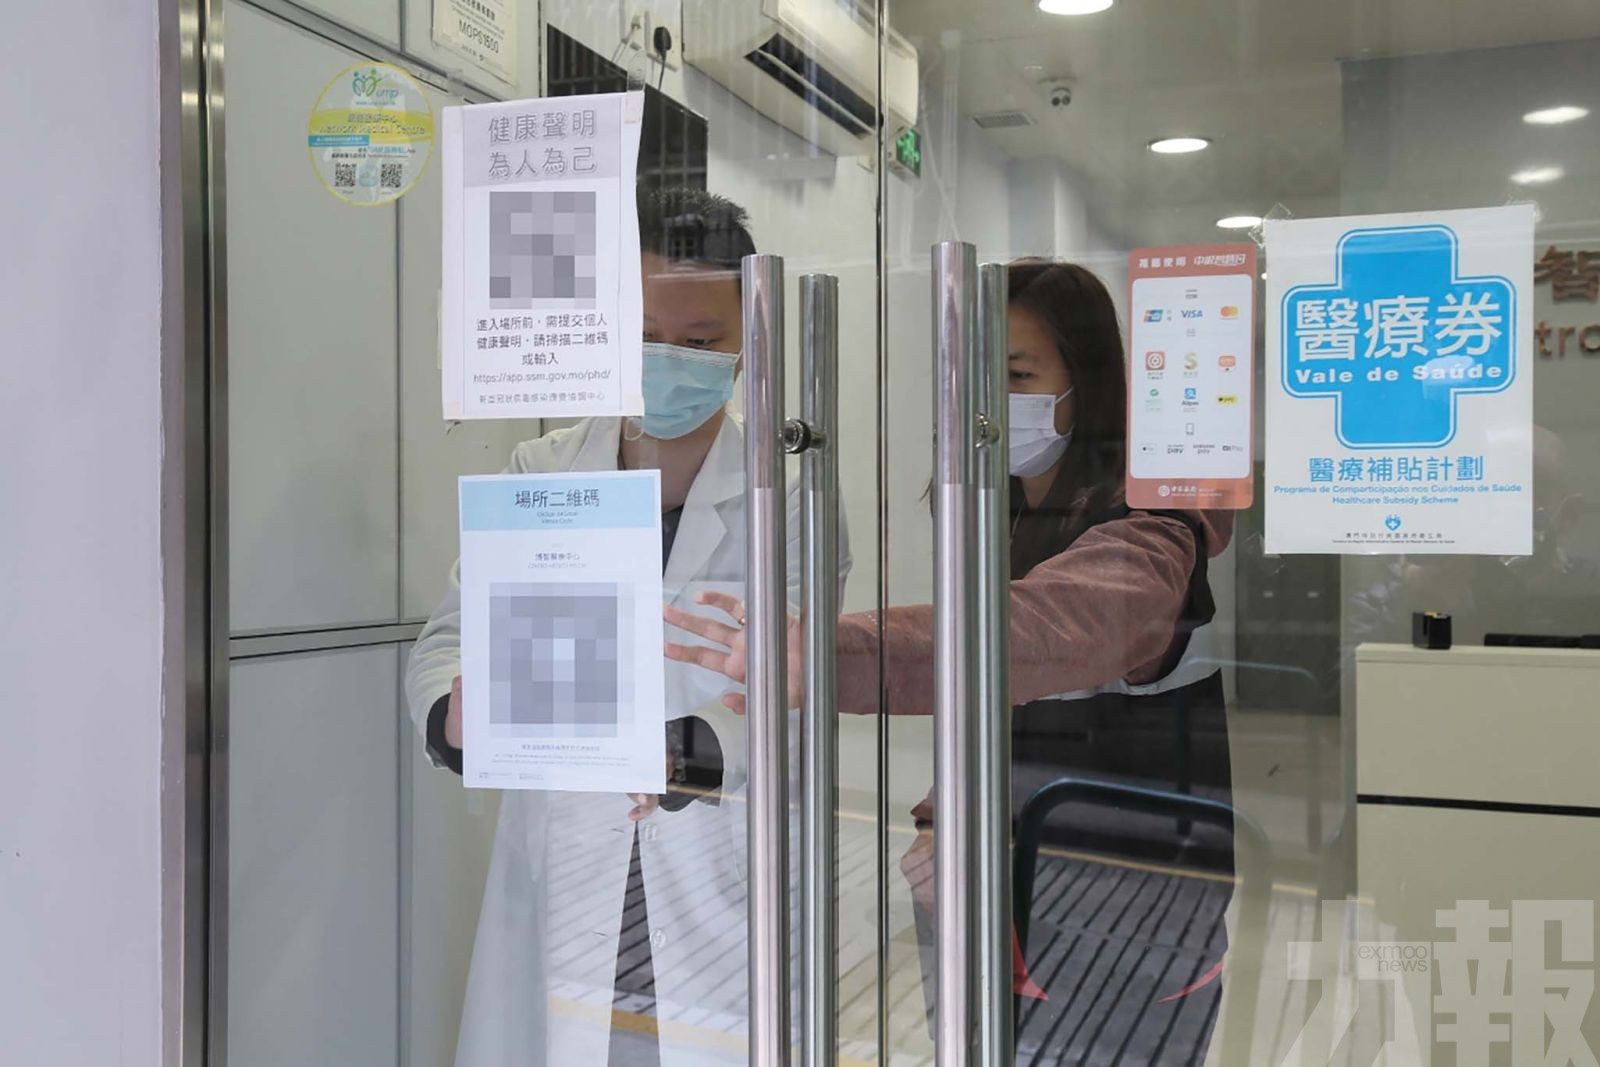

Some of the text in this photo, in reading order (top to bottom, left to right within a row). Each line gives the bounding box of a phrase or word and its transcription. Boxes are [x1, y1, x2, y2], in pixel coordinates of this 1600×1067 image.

[488, 110, 595, 144] 健康聲明
[488, 147, 595, 177] 為人為己
[1181, 310, 1204, 319] VISA
[1295, 292, 1502, 362] 醫療券
[522, 352, 559, 366] 或輸入
[473, 369, 611, 384] https://app.ssm.gov.mo/phd/
[1295, 364, 1503, 384] Vale de Saúde
[1309, 456, 1483, 482] 醫療補貼計劃
[514, 488, 600, 509] 場所二維碼
[1273, 485, 1317, 494] Programa
[1319, 485, 1330, 493] de
[1431, 484, 1475, 493] Cuidados
[1492, 483, 1522, 492] Saúde
[1332, 496, 1458, 505] Healthcare Subsidy Scheme
